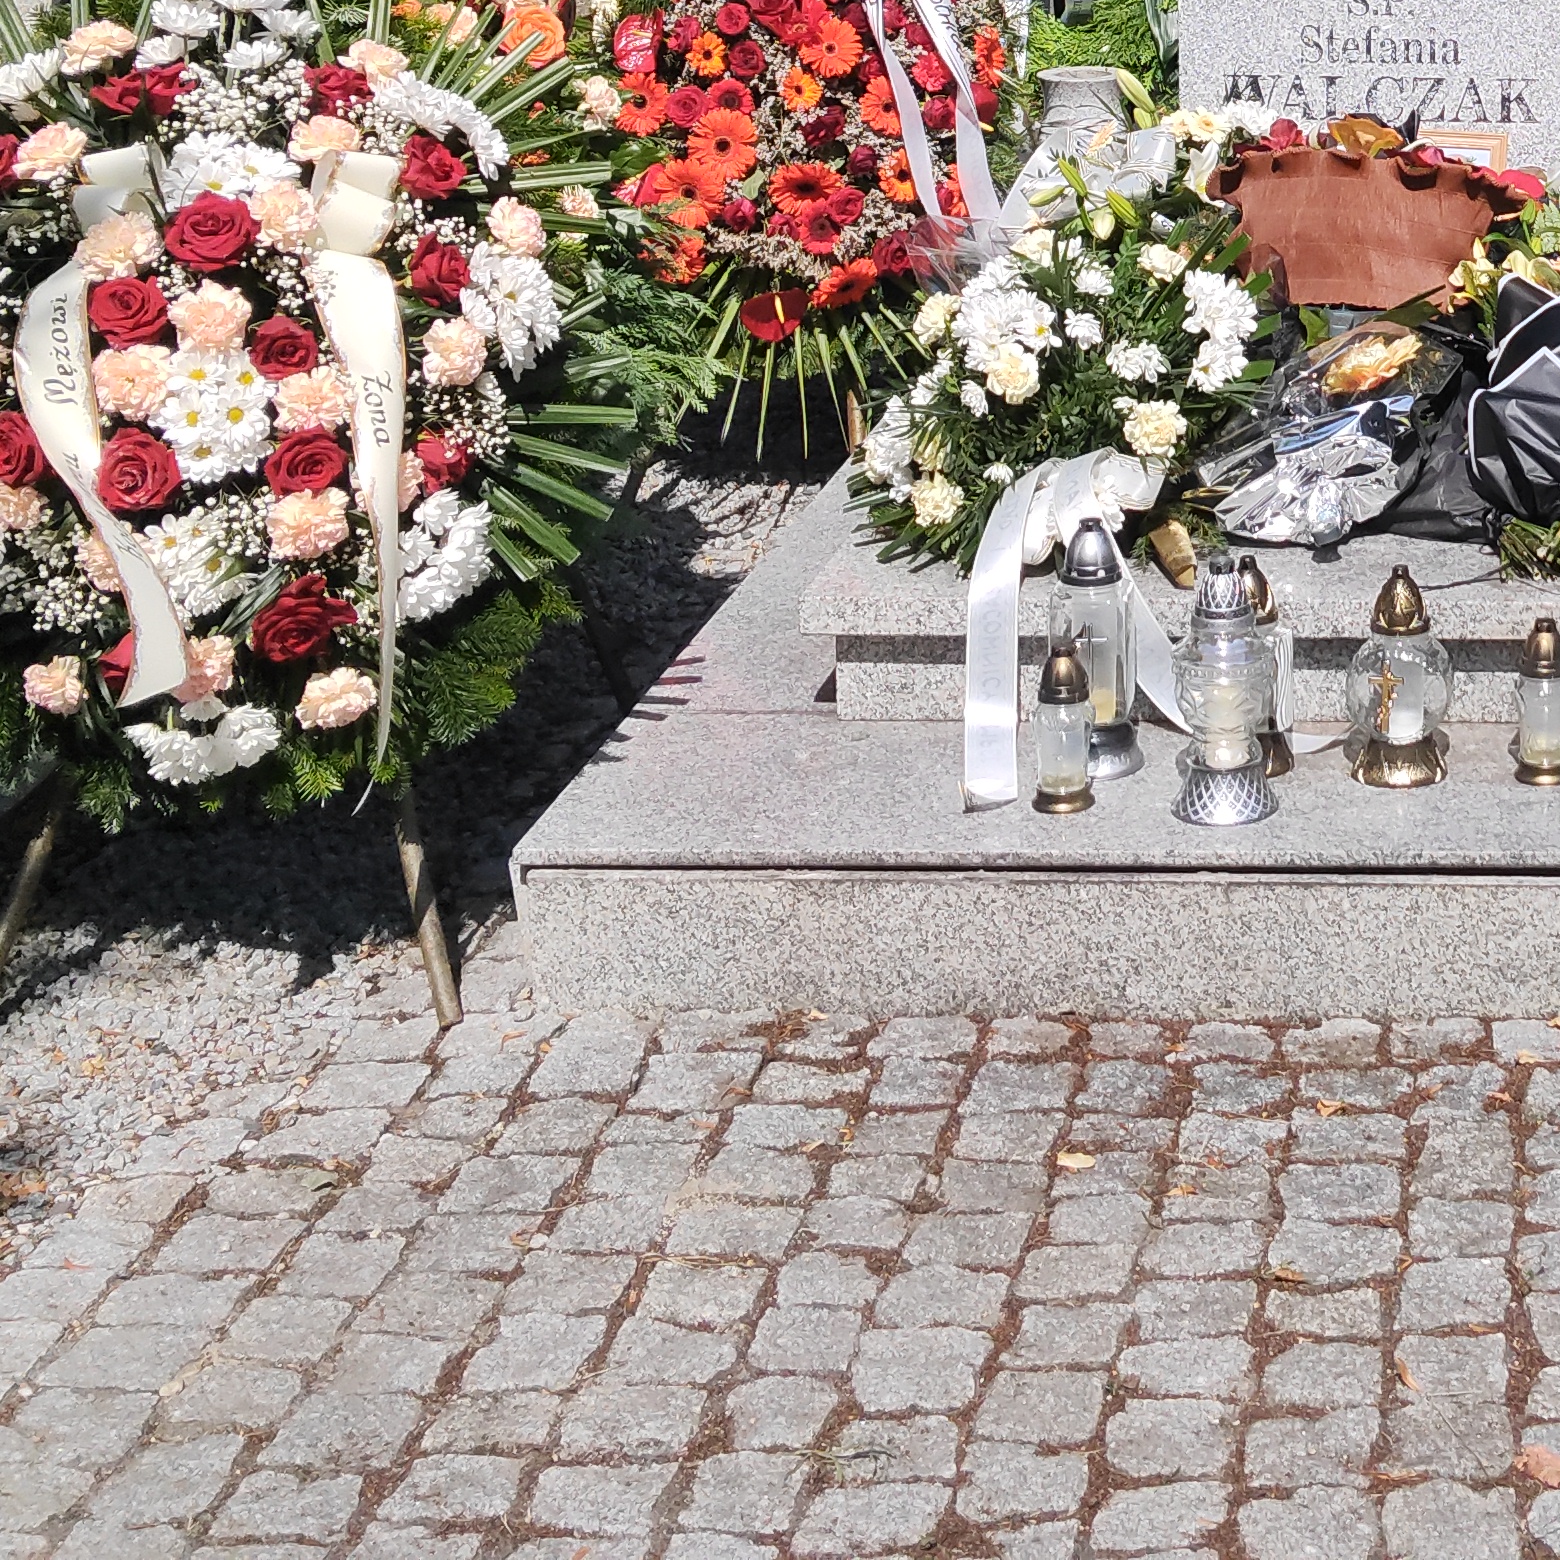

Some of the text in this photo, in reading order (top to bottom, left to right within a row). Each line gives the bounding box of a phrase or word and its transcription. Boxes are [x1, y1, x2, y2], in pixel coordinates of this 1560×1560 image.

[1299, 24, 1462, 66] Stefania
[43, 293, 78, 406] Mężowi
[361, 370, 393, 448] Żona
